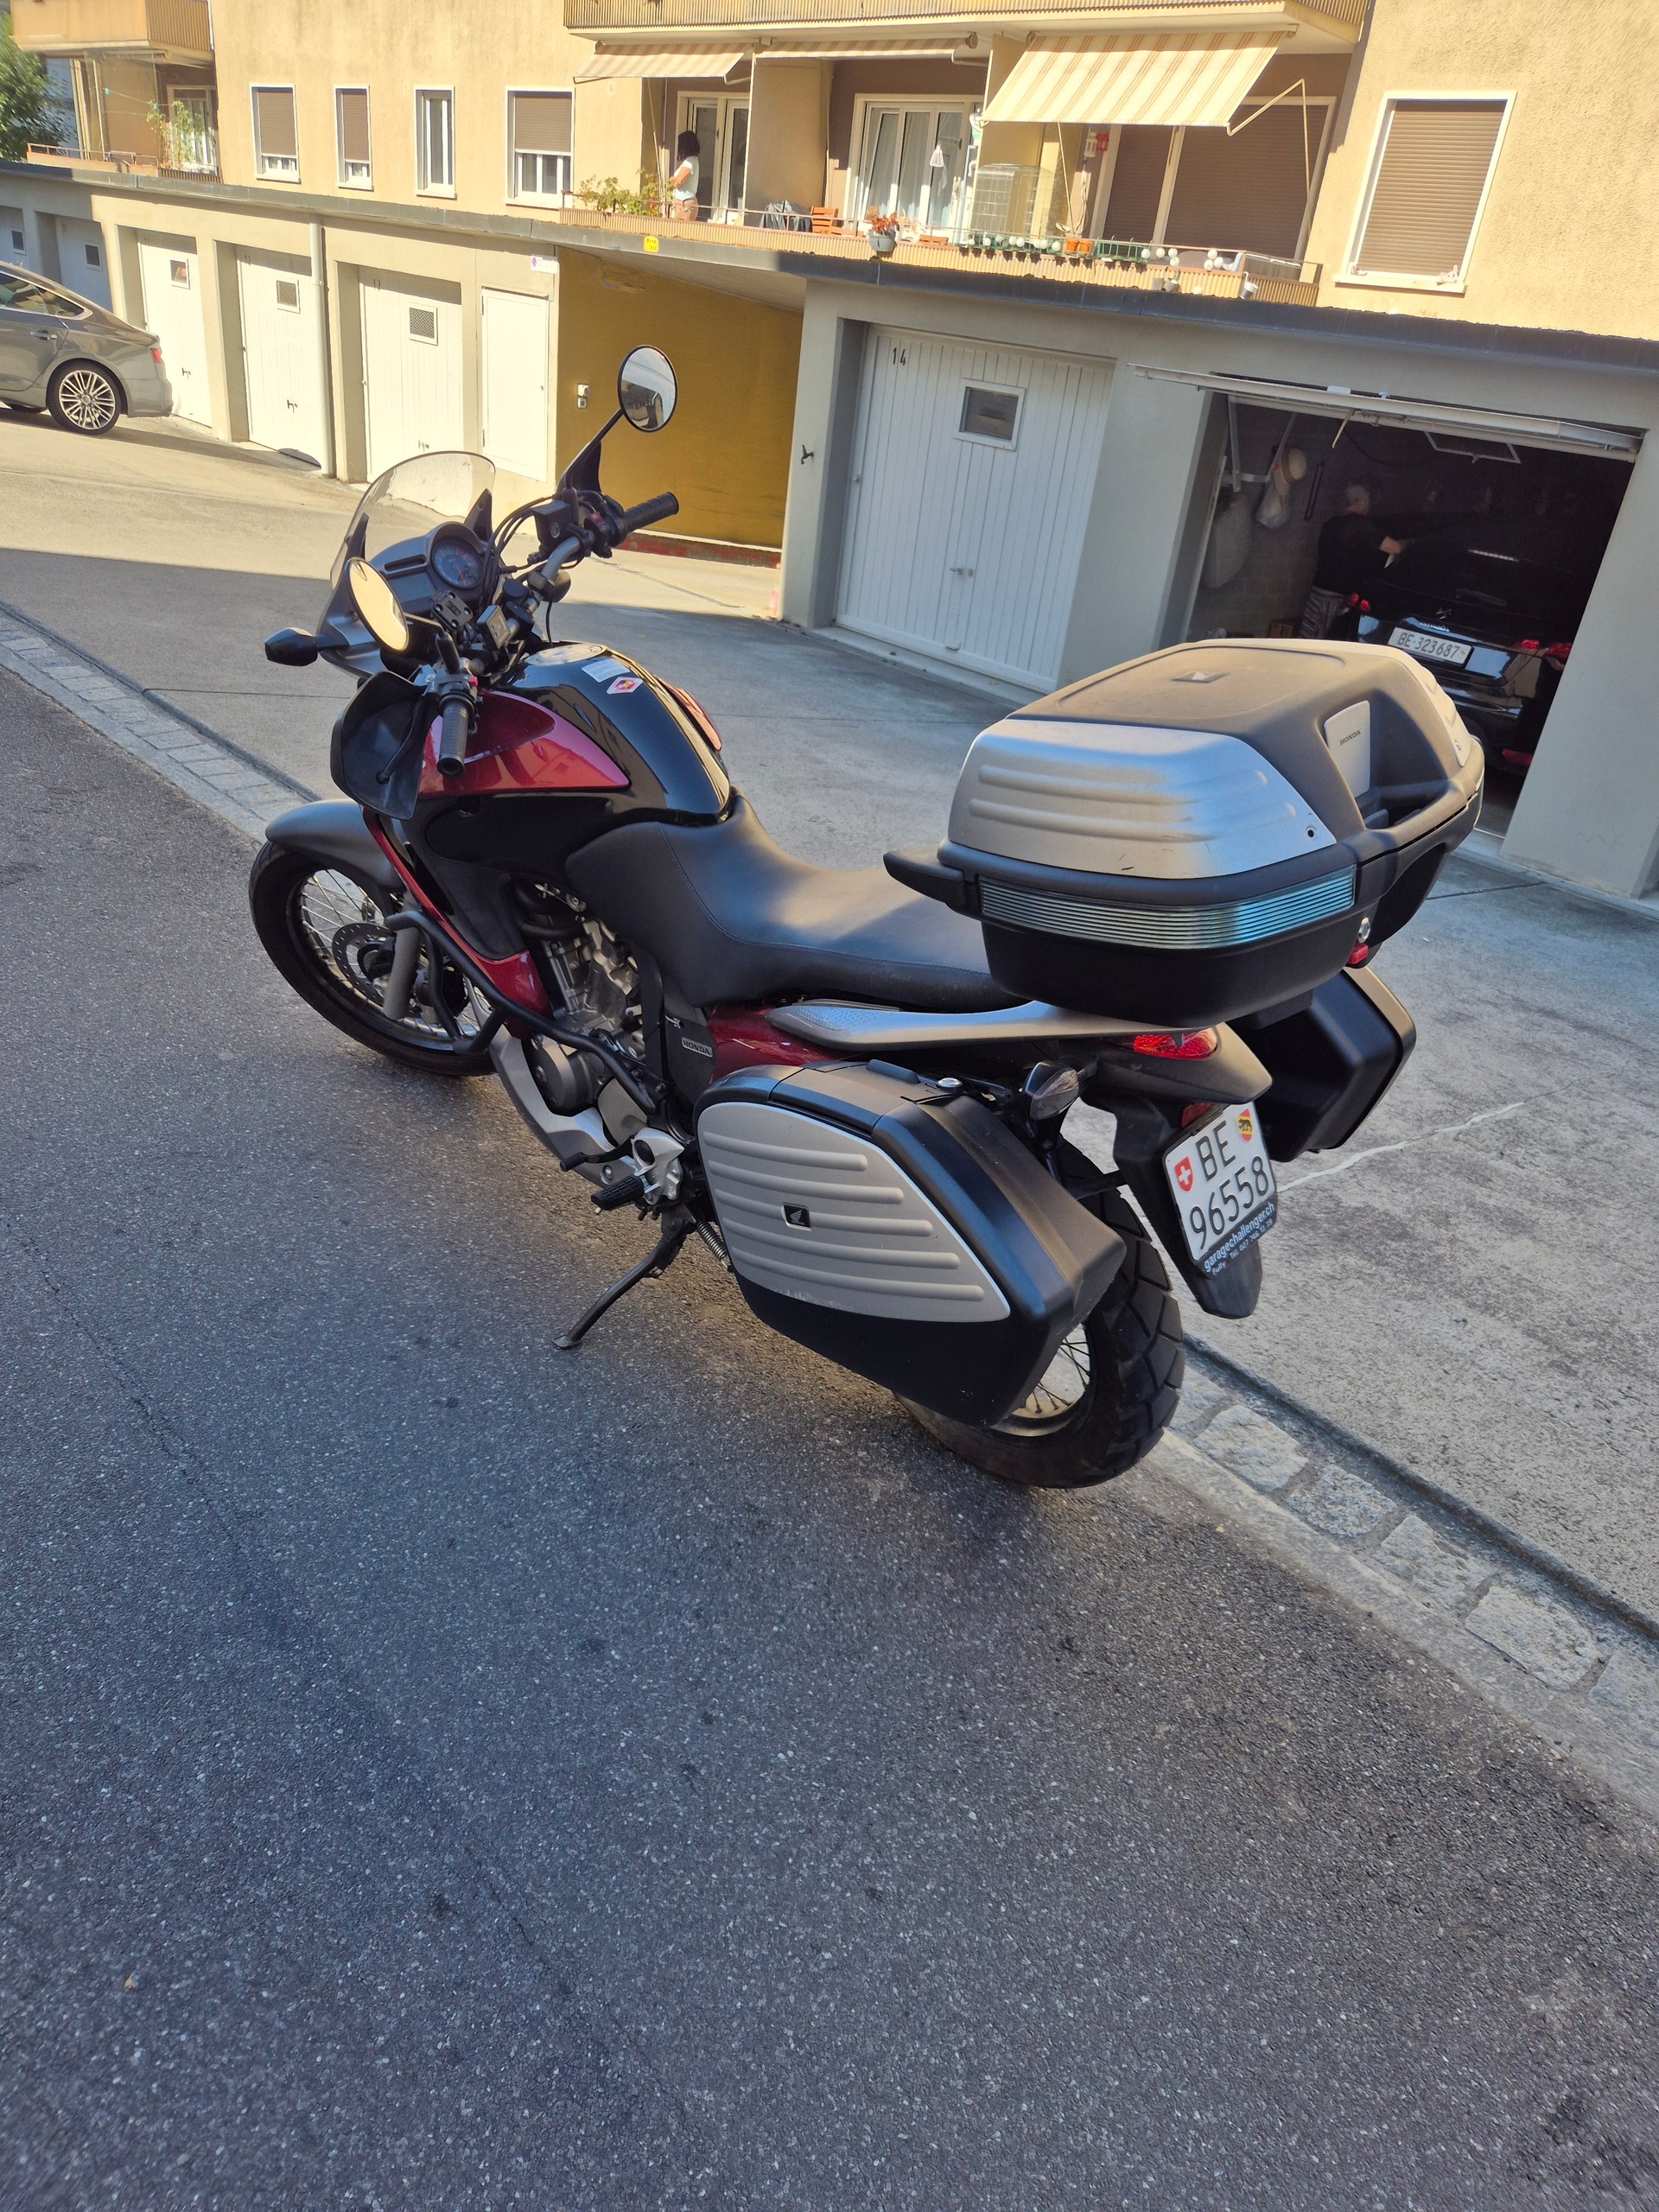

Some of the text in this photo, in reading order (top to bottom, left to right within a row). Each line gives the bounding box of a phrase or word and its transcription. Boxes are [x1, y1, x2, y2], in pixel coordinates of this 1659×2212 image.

[893, 346, 906, 366] 14
[1339, 729, 1362, 746] HONDA
[683, 1039, 710, 1055] HONDA
[1195, 1120, 1236, 1182] BE
[1189, 1155, 1269, 1250] 96558
[1204, 1201, 1275, 1273] garagechallenger.ch
[1211, 1262, 1226, 1275] Fully
